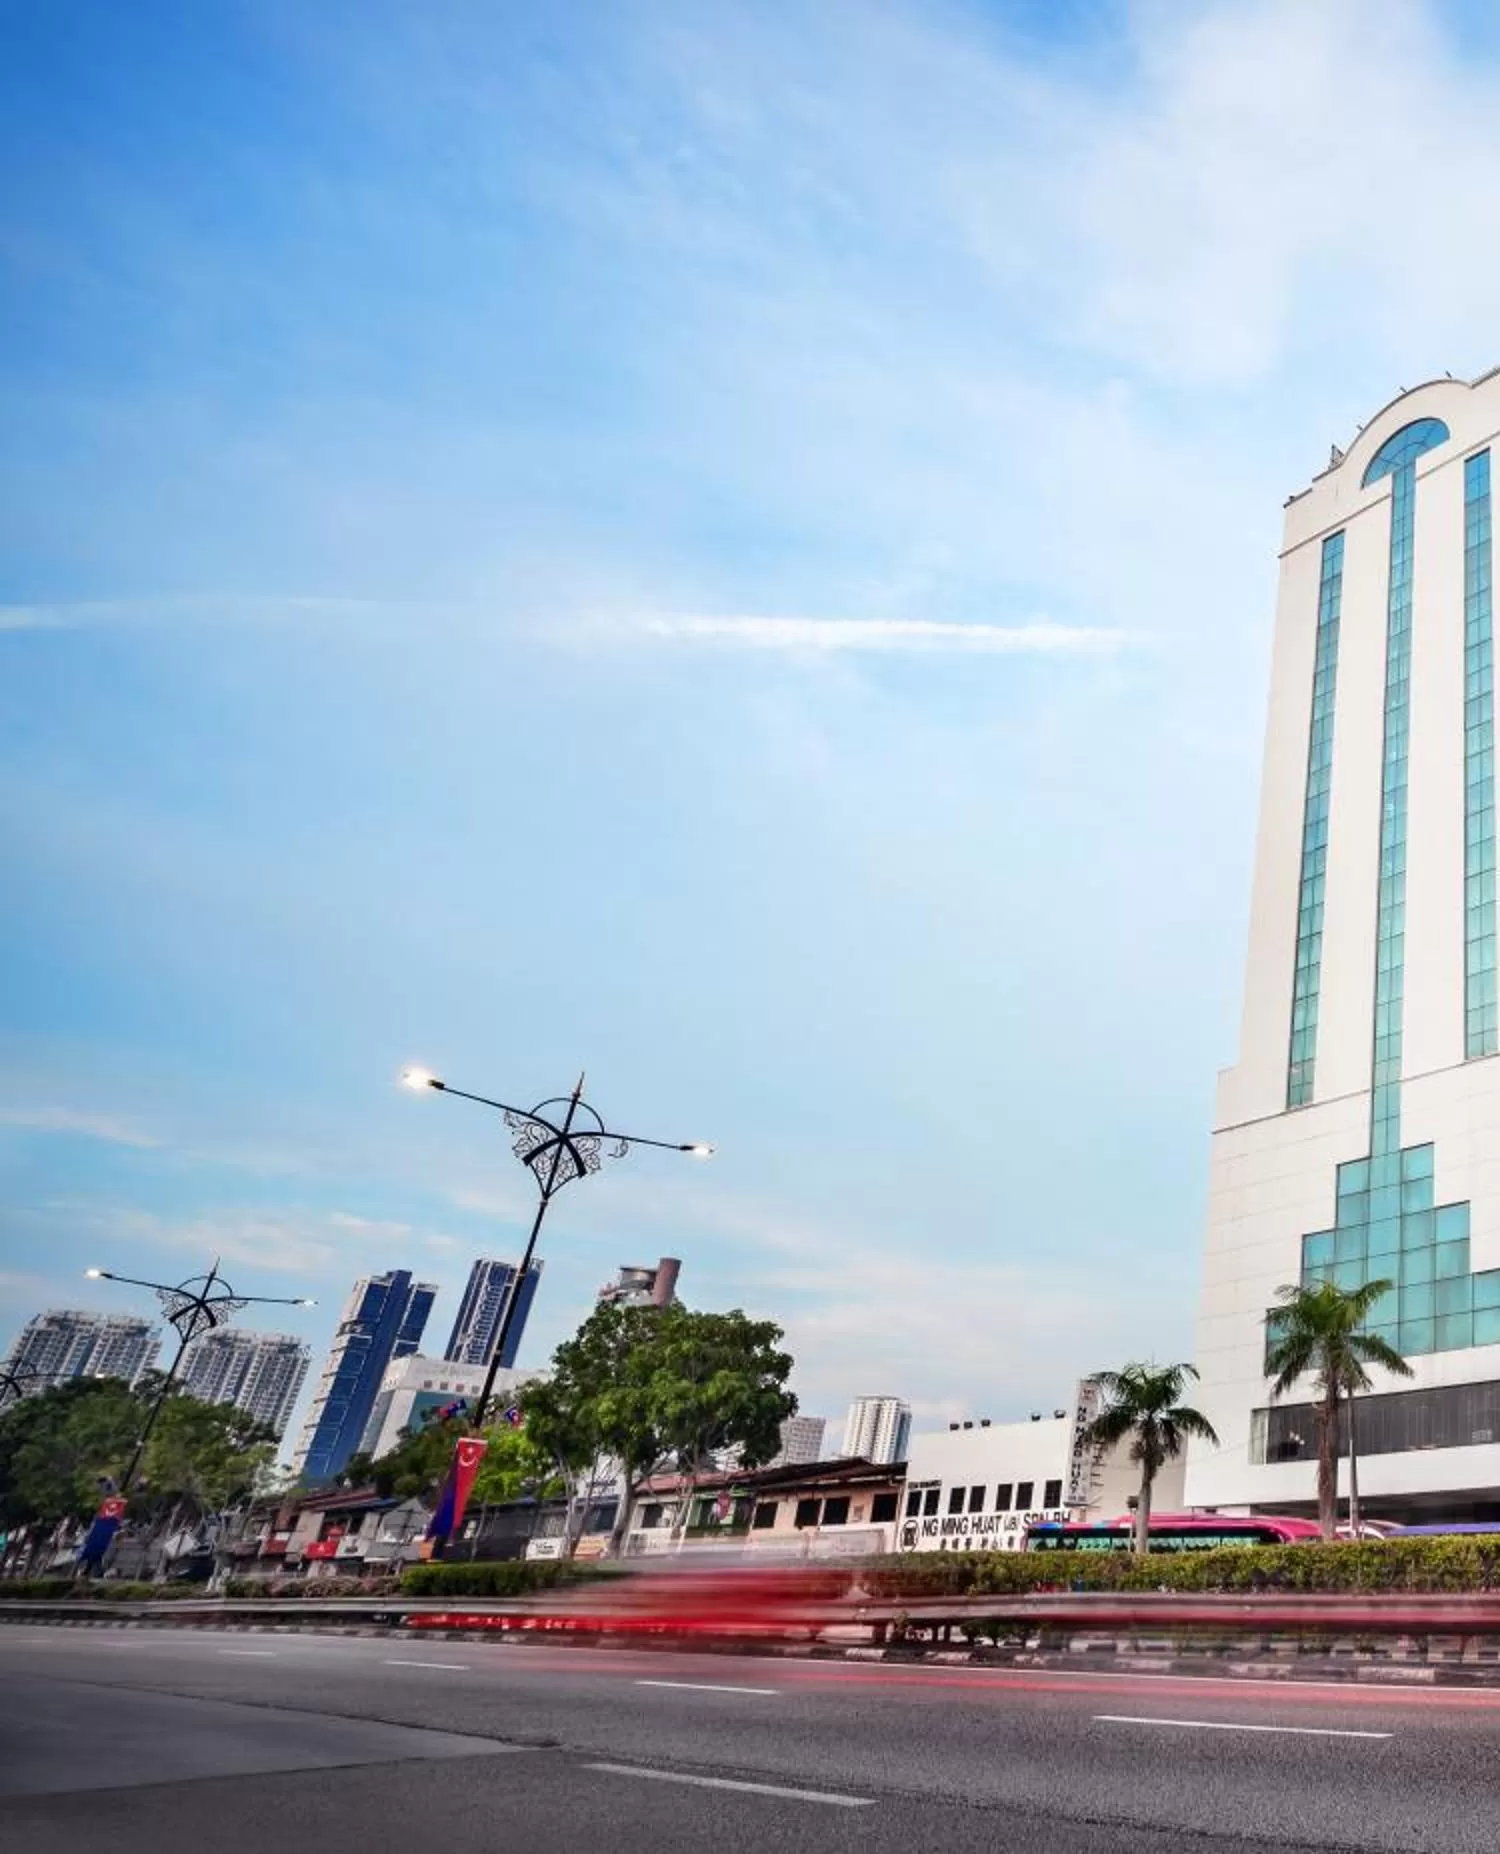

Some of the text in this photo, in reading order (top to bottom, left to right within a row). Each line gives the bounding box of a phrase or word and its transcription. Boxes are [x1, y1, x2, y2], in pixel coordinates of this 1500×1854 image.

[921, 1519, 938, 1537] NG
[939, 1517, 969, 1536] MING
[970, 1515, 1001, 1534] HUAT
